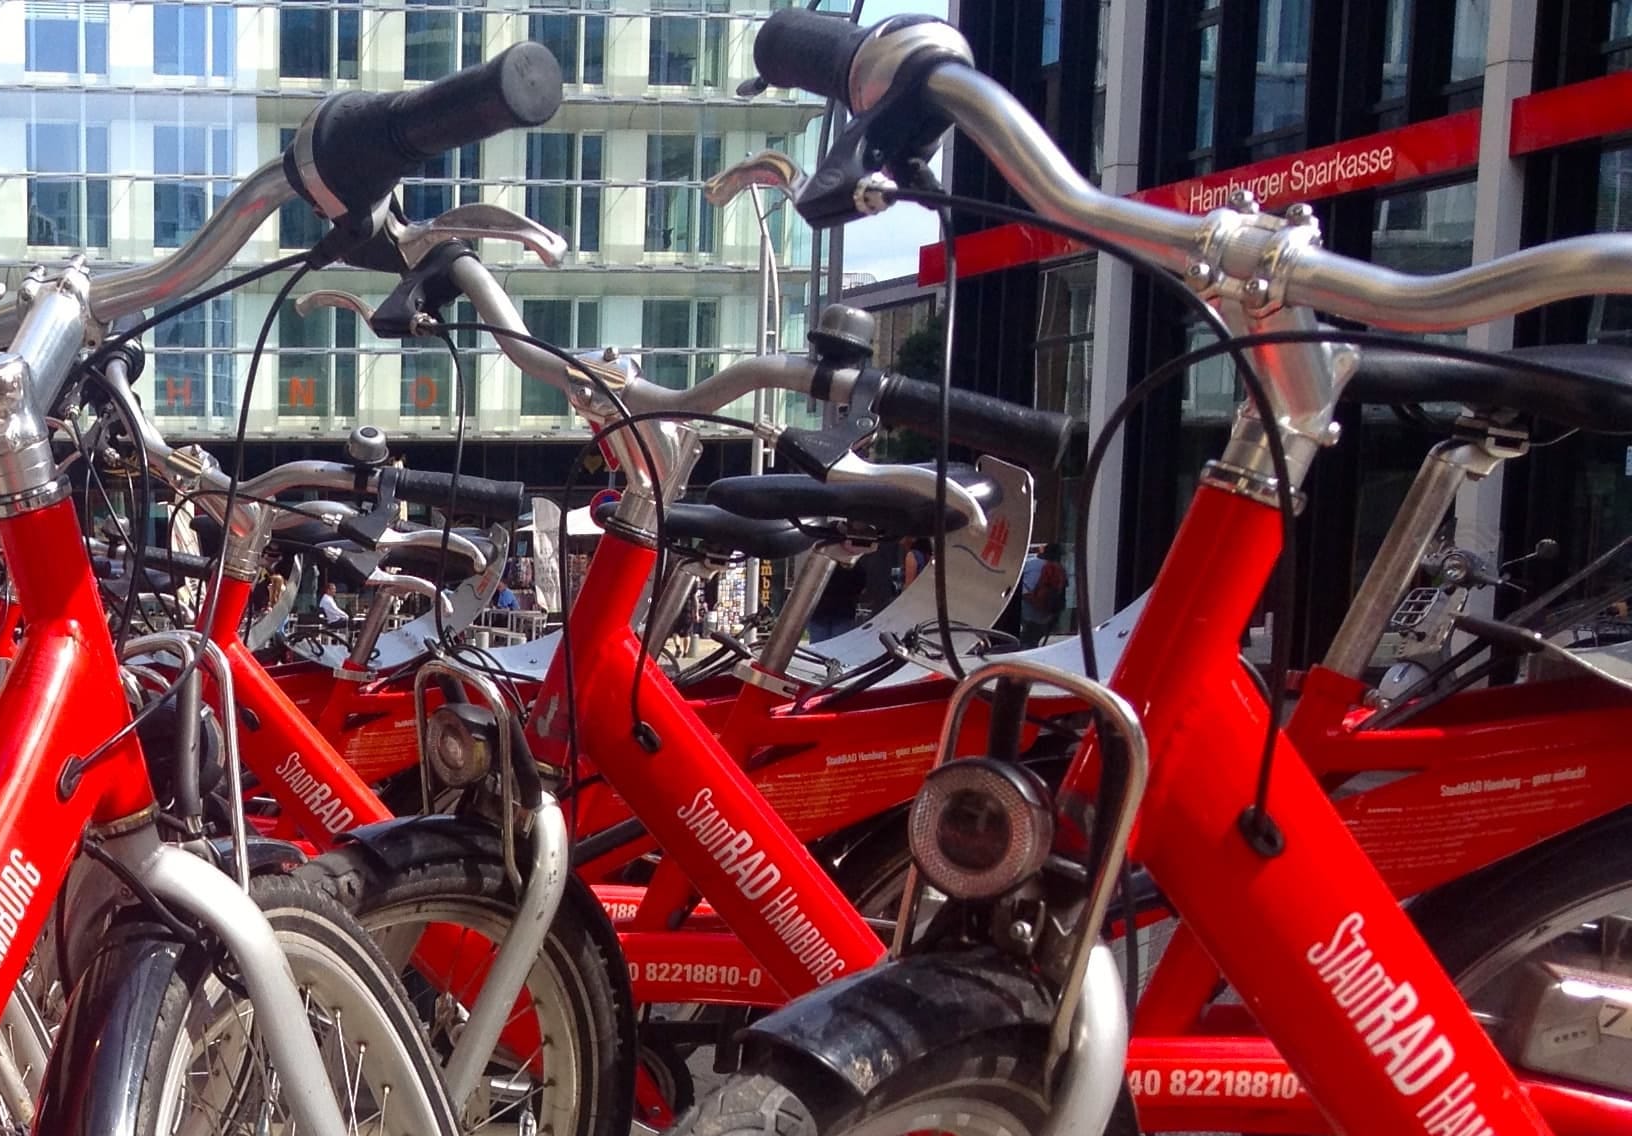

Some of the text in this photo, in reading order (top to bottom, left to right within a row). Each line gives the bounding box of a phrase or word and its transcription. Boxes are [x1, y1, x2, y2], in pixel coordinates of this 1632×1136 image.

[1289, 146, 1393, 194] Sparkasse
[1483, 777, 1521, 791] Hamburg
[759, 886, 846, 986] HAMBURG
[645, 962, 762, 988] 82218810-0
